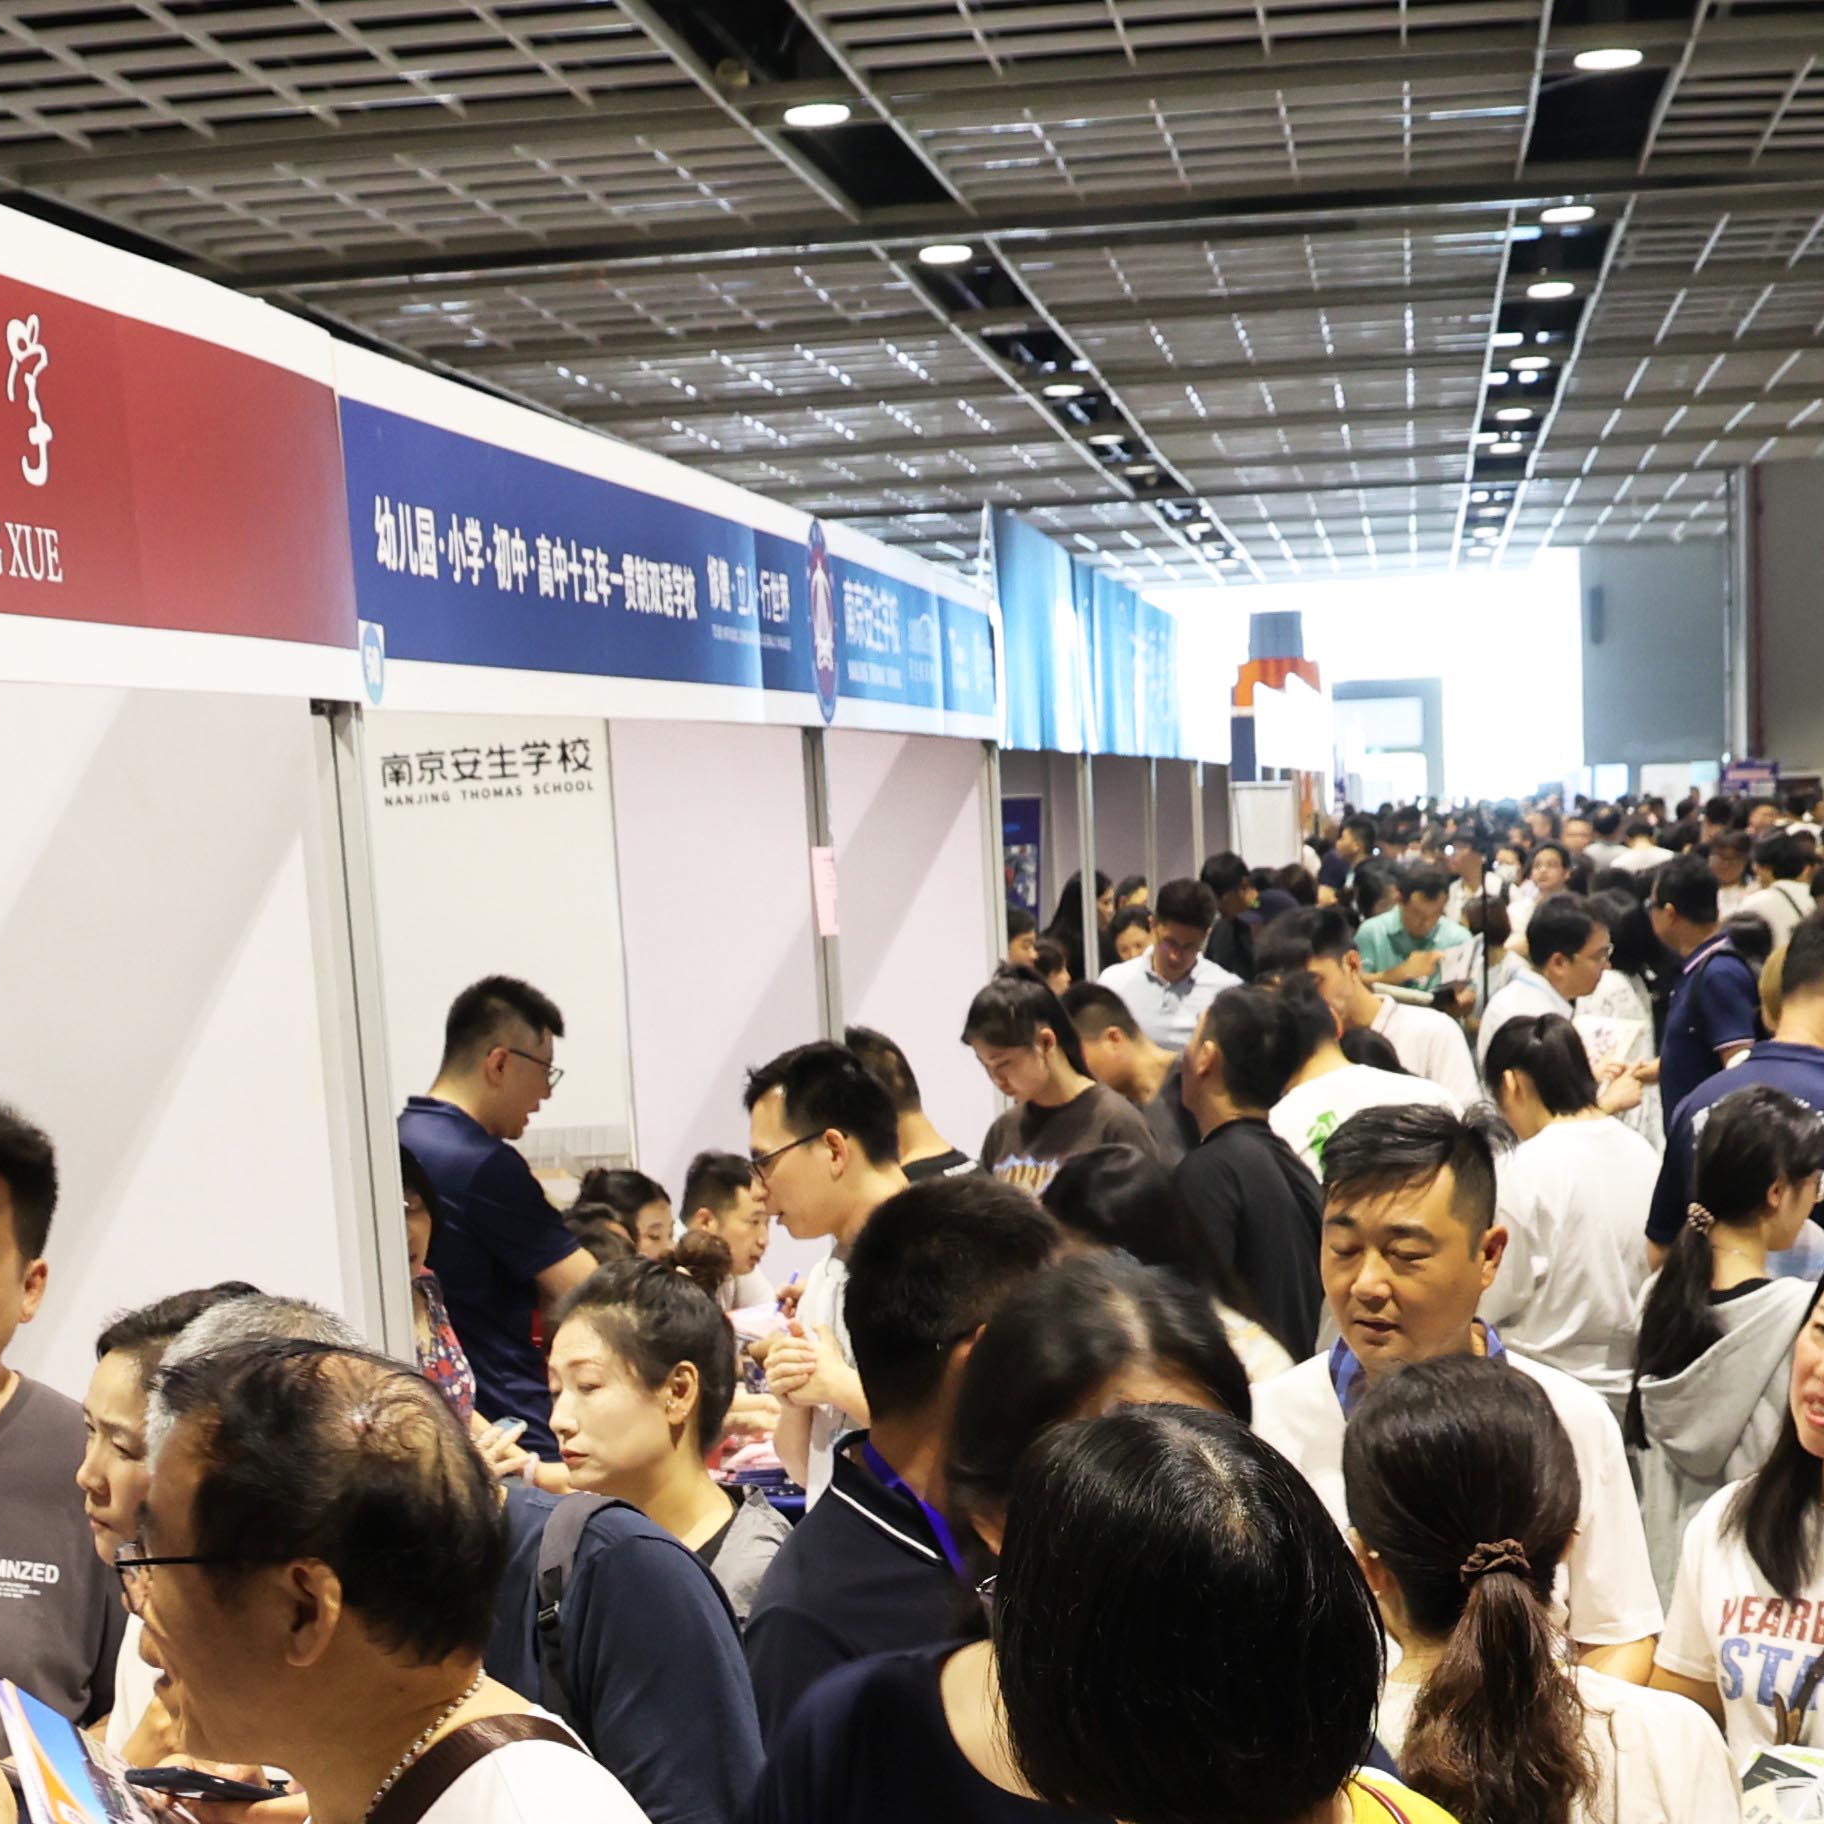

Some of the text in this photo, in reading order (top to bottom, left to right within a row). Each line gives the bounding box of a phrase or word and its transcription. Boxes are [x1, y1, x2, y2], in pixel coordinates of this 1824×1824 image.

[4, 522, 64, 583] XUE
[381, 736, 593, 788] 南京安生学校
[384, 780, 594, 807] NANJING THOMAS SCHOOL
